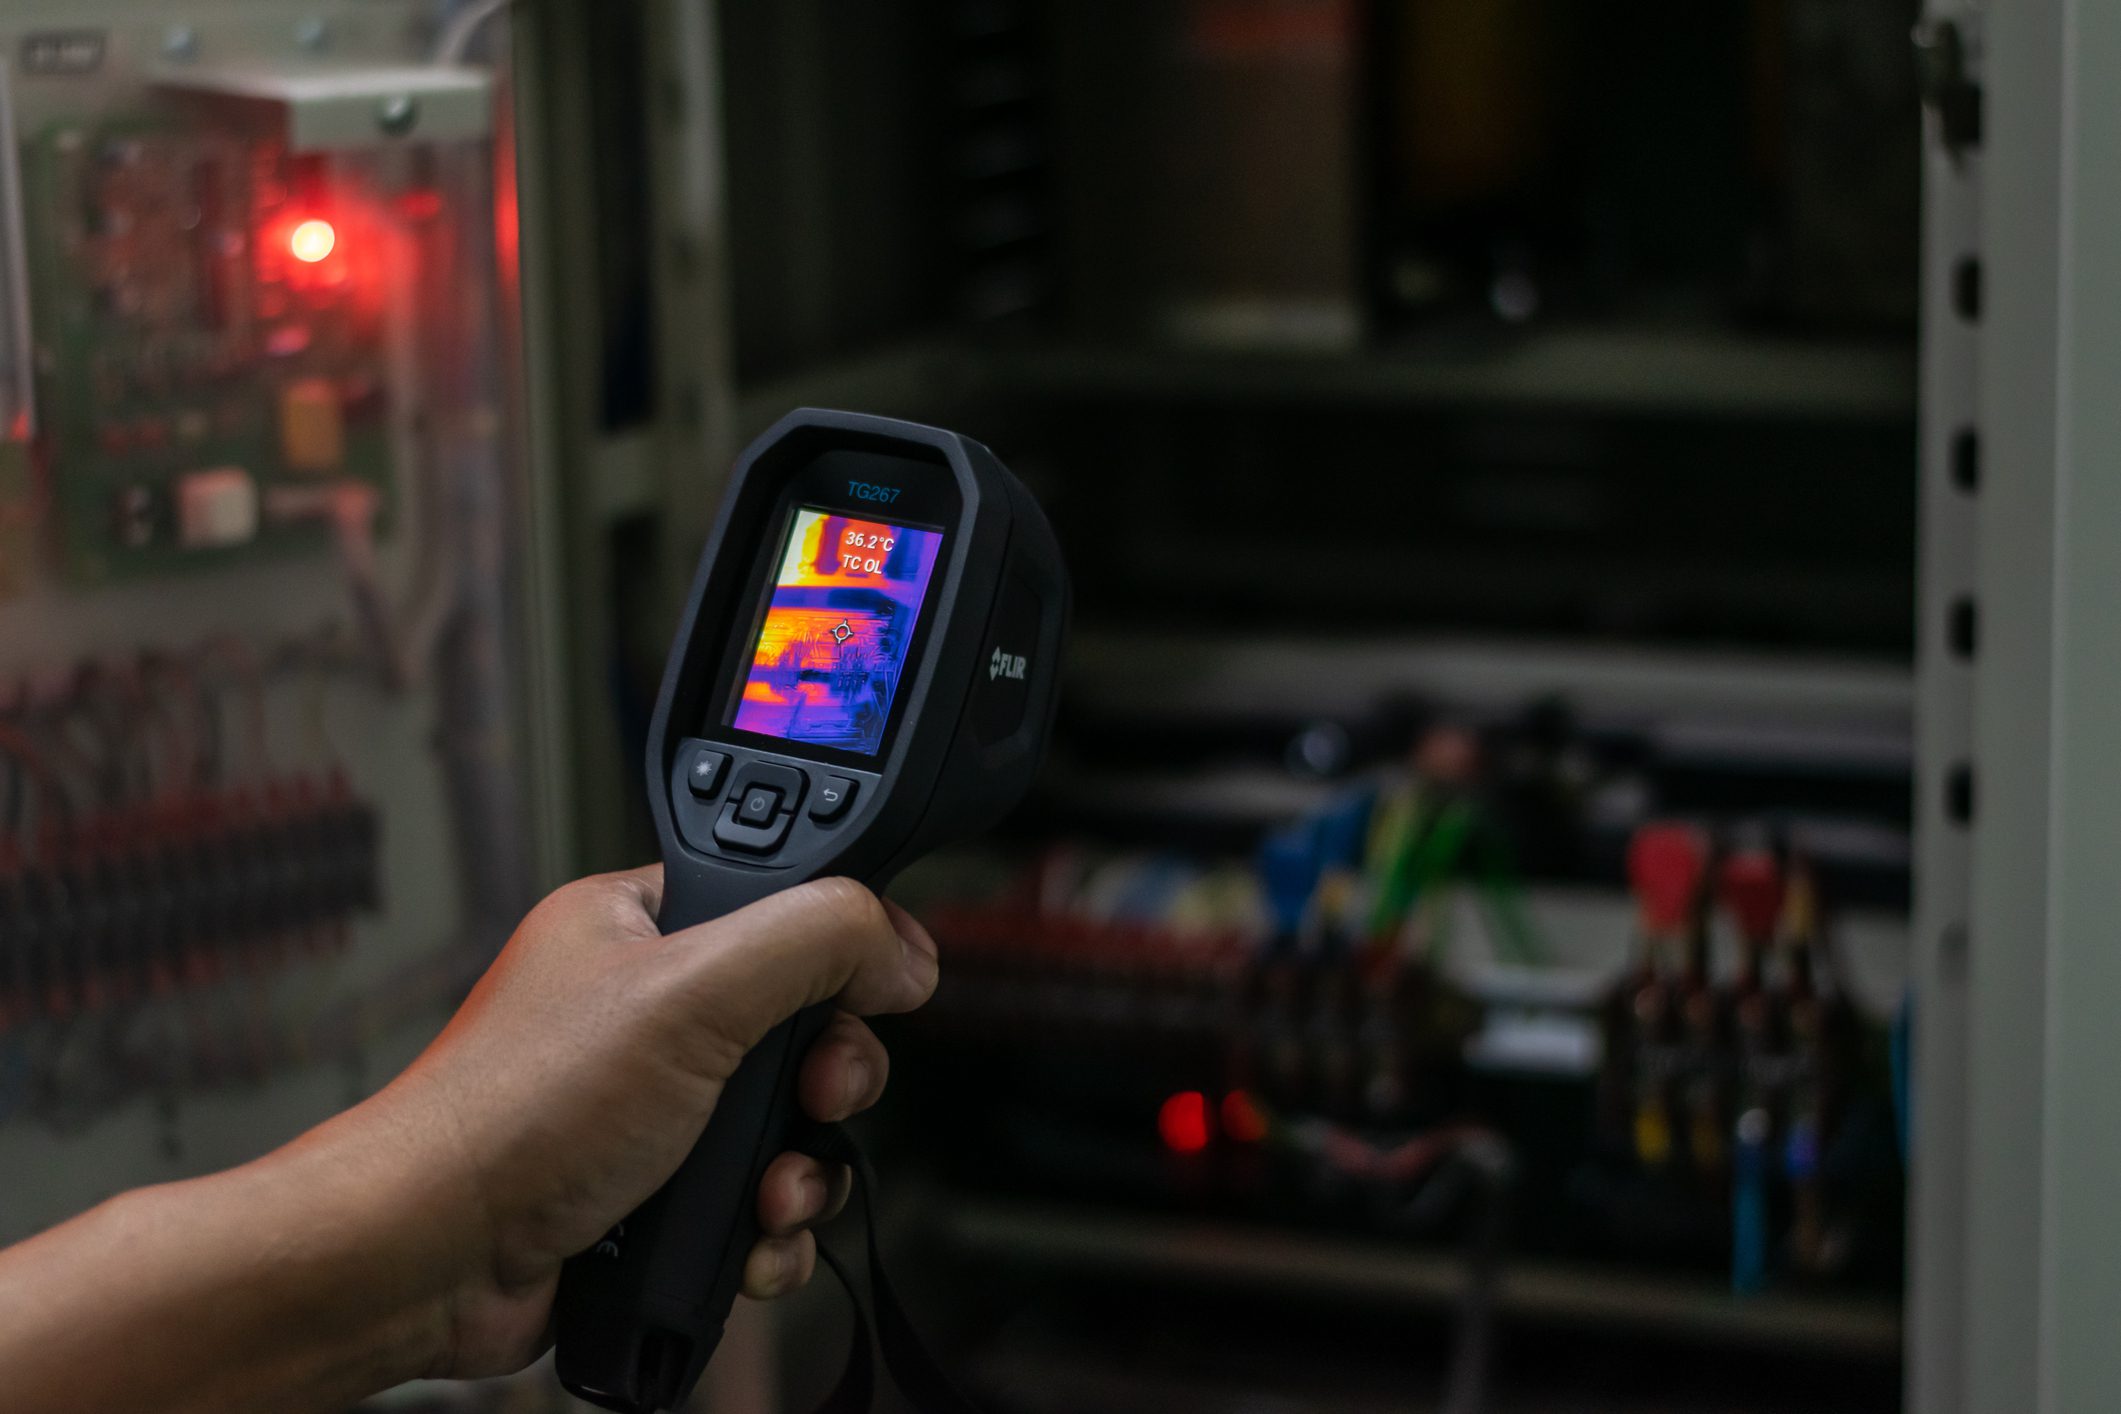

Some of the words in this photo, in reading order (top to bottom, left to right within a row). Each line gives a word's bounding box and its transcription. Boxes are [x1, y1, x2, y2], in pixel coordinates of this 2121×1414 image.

[848, 480, 901, 503] TG267
[845, 531, 895, 552] 36.2°C
[842, 554, 862, 570] TC
[864, 558, 882, 574] OL
[999, 653, 1027, 680] FLIR
